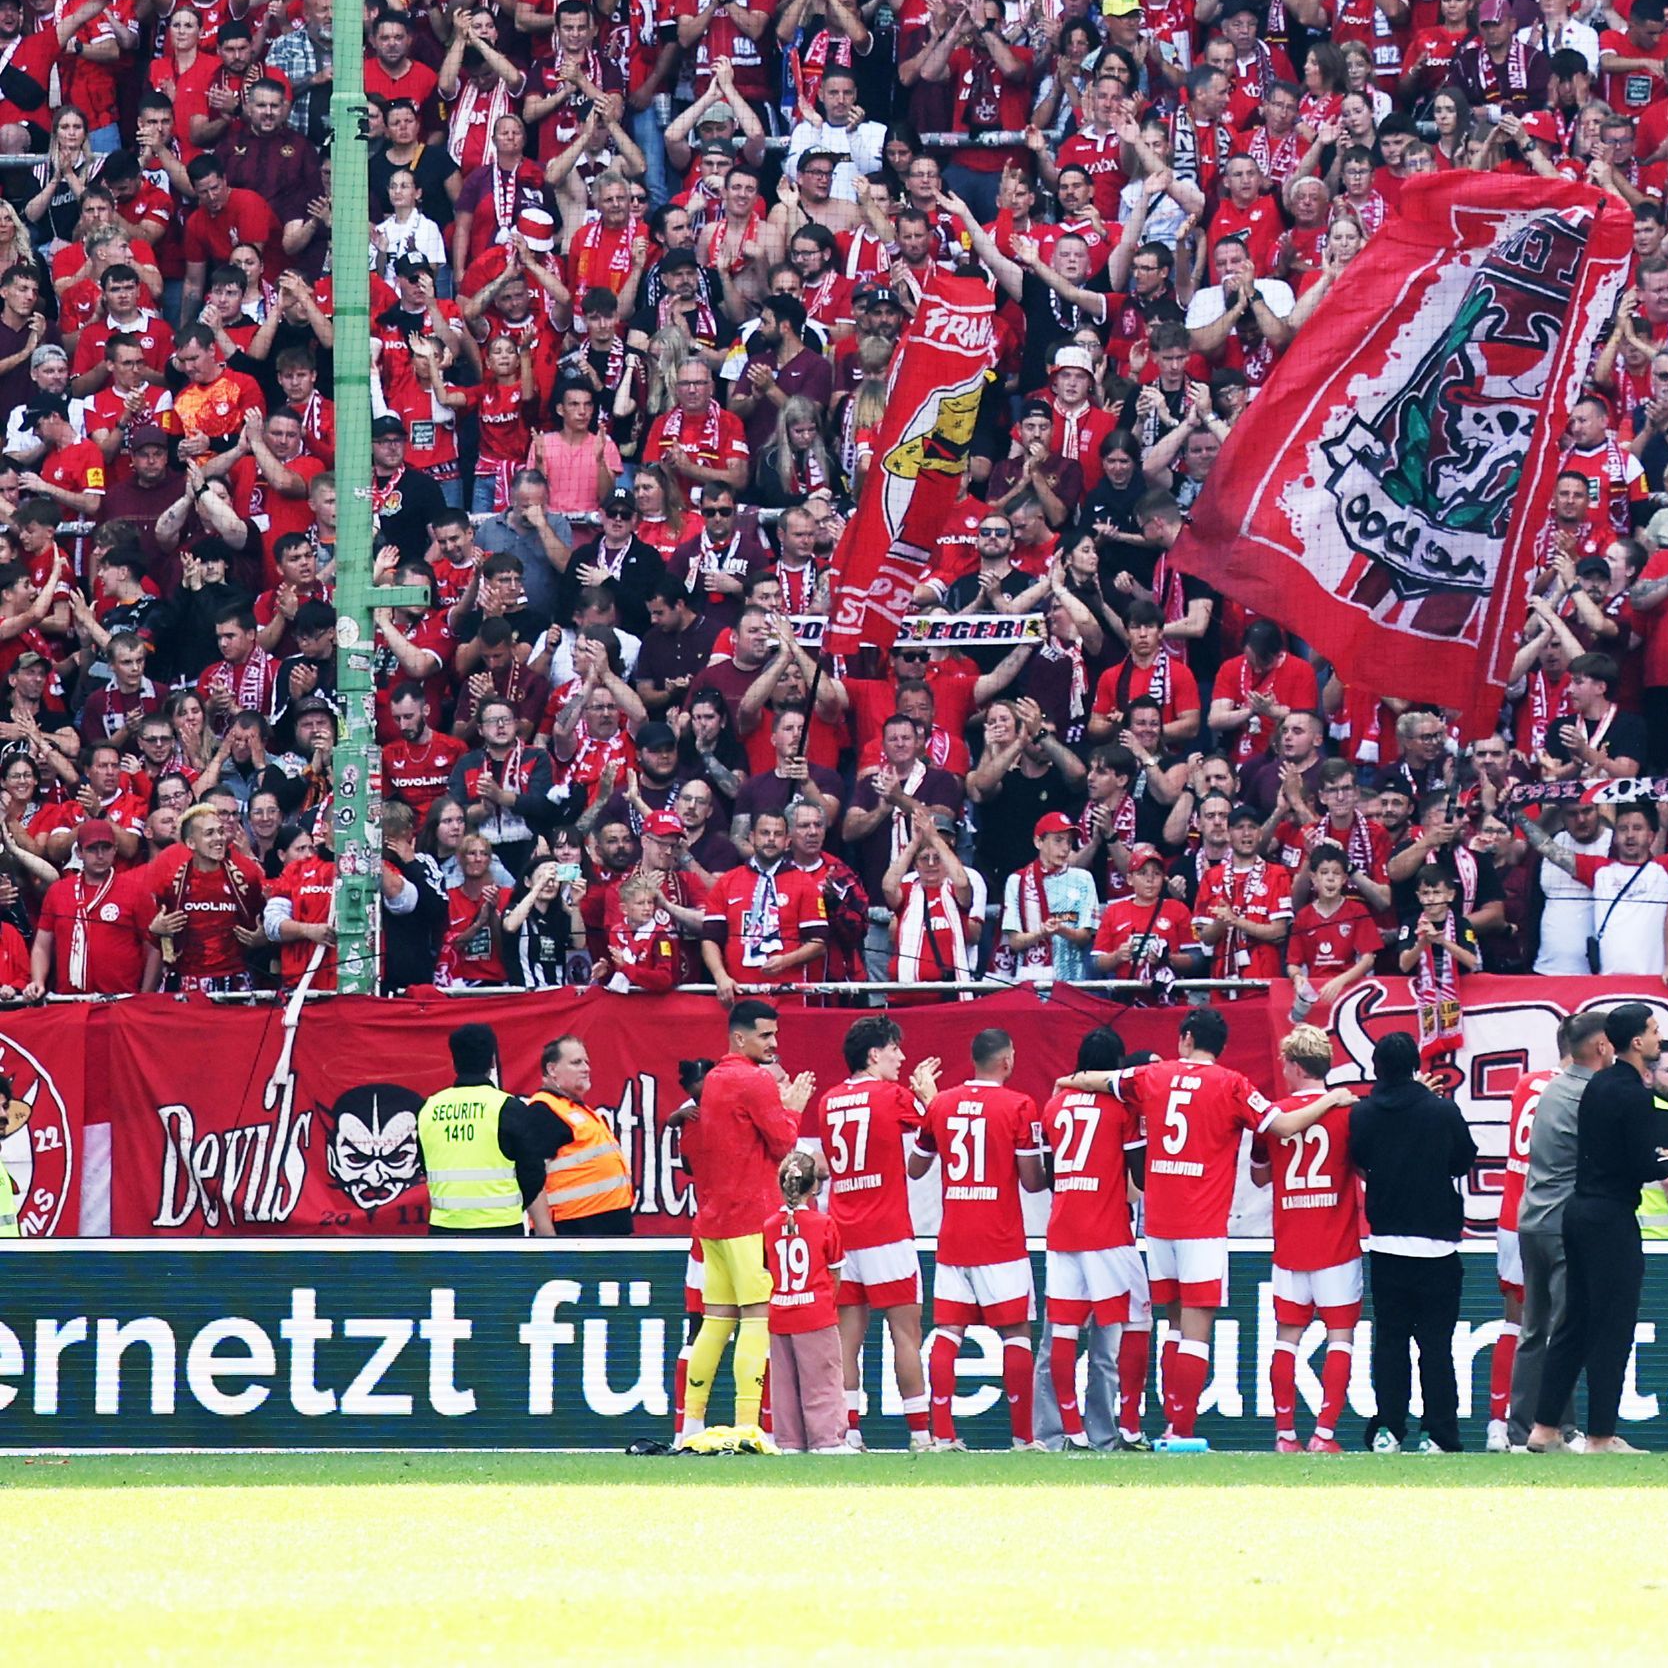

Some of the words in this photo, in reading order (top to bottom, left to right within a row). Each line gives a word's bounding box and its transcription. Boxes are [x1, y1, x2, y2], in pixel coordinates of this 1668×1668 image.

[391, 775, 449, 789] NOVOLINE
[182, 901, 237, 913] OVOLIN
[431, 1102, 487, 1123] SECURITY
[826, 1093, 869, 1111] ROBINSON
[1162, 1090, 1192, 1155] 5
[33, 1128, 60, 1152] 22
[152, 1069, 312, 1229] Devils
[443, 1124, 475, 1144] 1410
[826, 1107, 871, 1175] 37
[946, 1116, 986, 1182] 31
[1052, 1107, 1102, 1173] 27
[1279, 1123, 1332, 1191] 22
[774, 1237, 810, 1292] 19
[0, 1288, 478, 1417] rnetzt
[518, 1279, 690, 1417] fü
